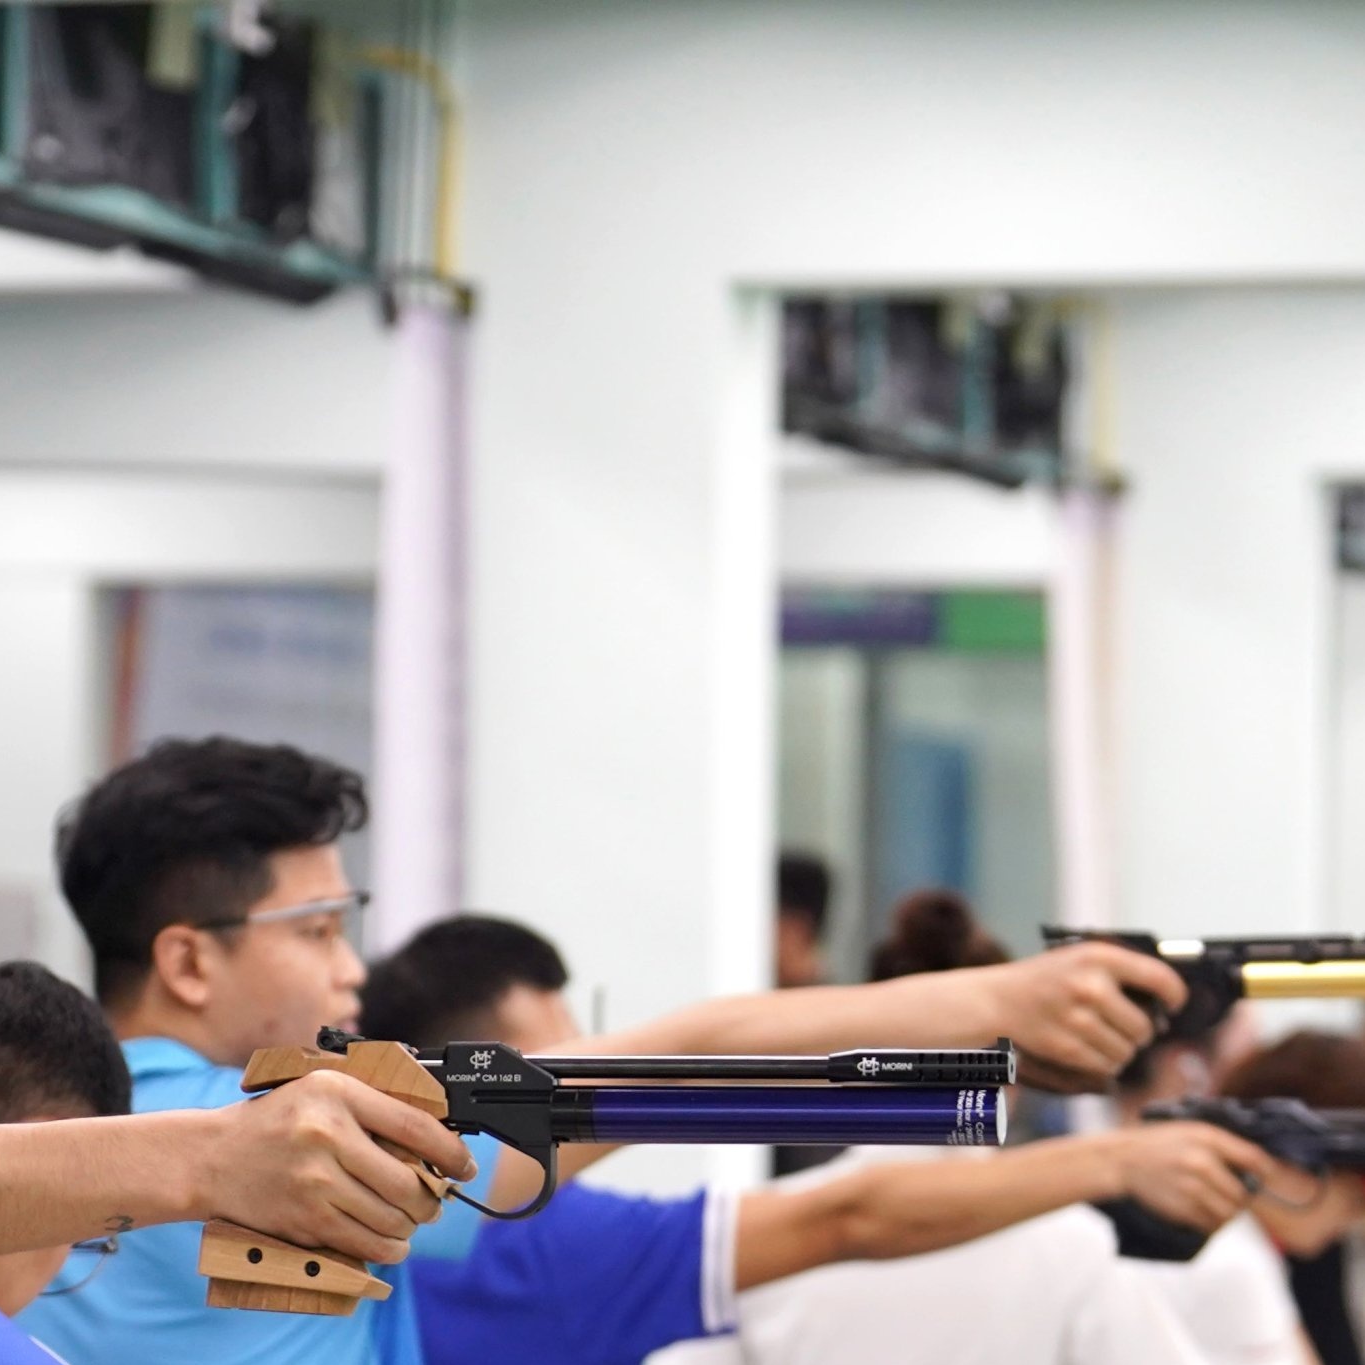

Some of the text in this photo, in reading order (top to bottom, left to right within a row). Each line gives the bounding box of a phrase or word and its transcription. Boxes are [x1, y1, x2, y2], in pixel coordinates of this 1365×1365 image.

[881, 1062, 913, 1071] MORINI
[482, 1074, 497, 1082] CM
[499, 1074, 513, 1082] 162
